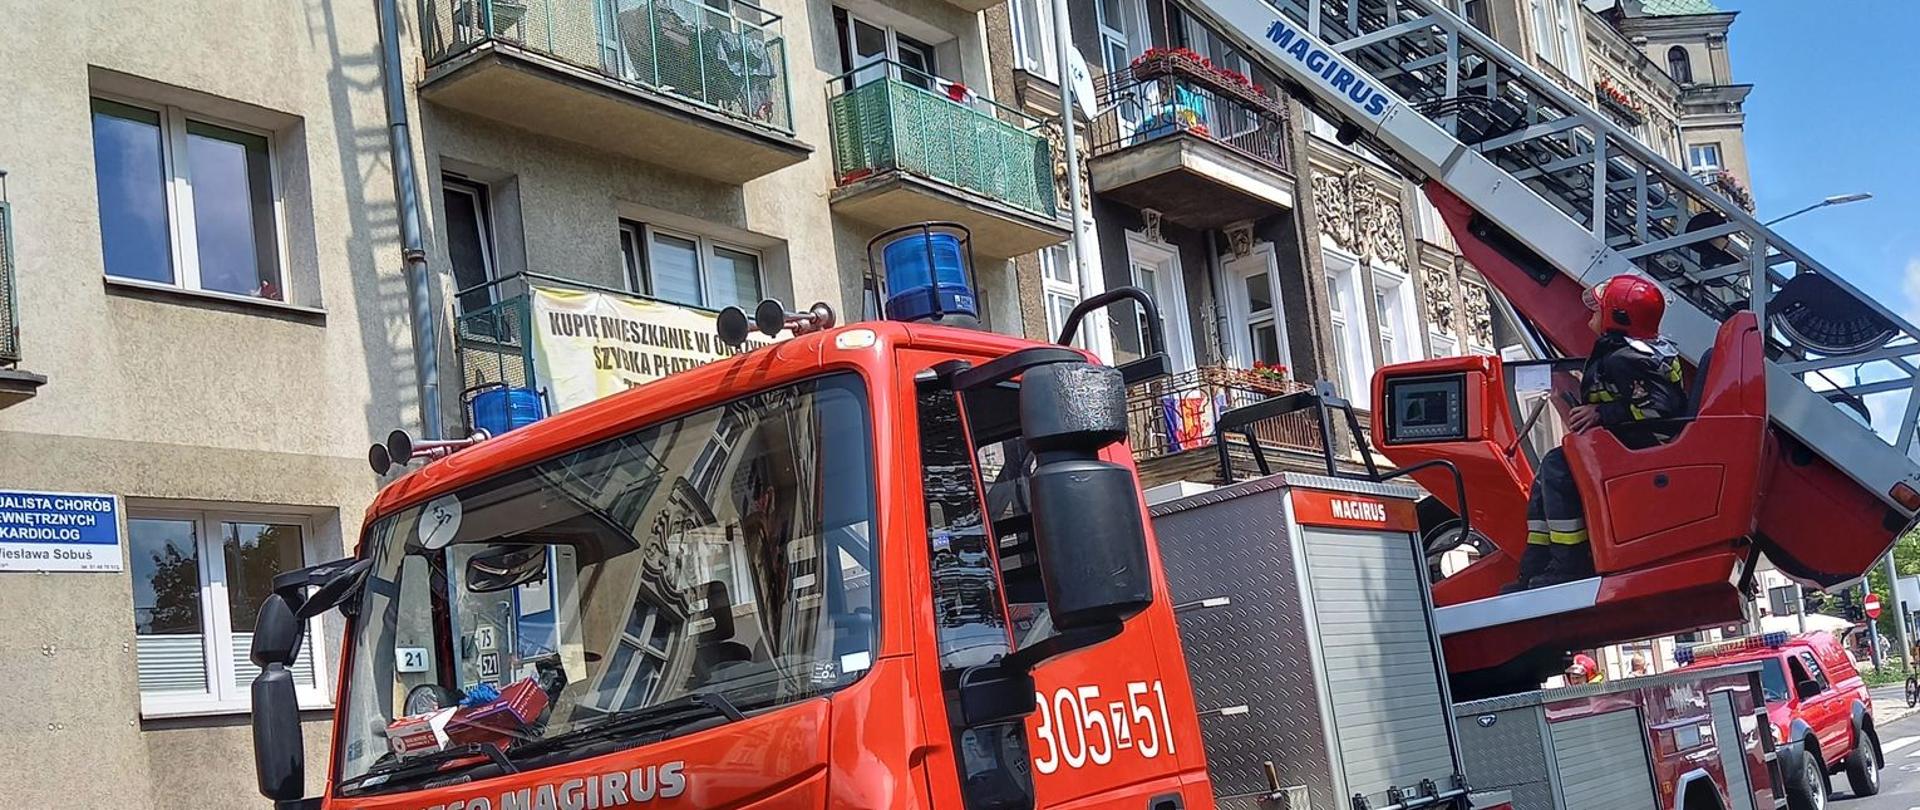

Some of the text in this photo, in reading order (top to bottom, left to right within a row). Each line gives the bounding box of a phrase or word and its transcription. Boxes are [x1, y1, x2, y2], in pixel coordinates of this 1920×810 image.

[1265, 20, 1389, 116] MAGIRUS
[549, 312, 599, 342] KUPIĘ
[600, 314, 693, 351] MIESZKANIE
[694, 331, 710, 354] W
[593, 345, 651, 375] SZYBKA
[54, 498, 112, 512] CHORÓB
[1330, 499, 1386, 522] MAGIRUS
[0, 526, 80, 541] KARDIOLOG
[0, 548, 93, 560] iesława Sobuś
[481, 629, 492, 648] 75
[404, 651, 423, 667] 21
[482, 654, 499, 675] 521
[501, 760, 687, 810] MAGIRUS
